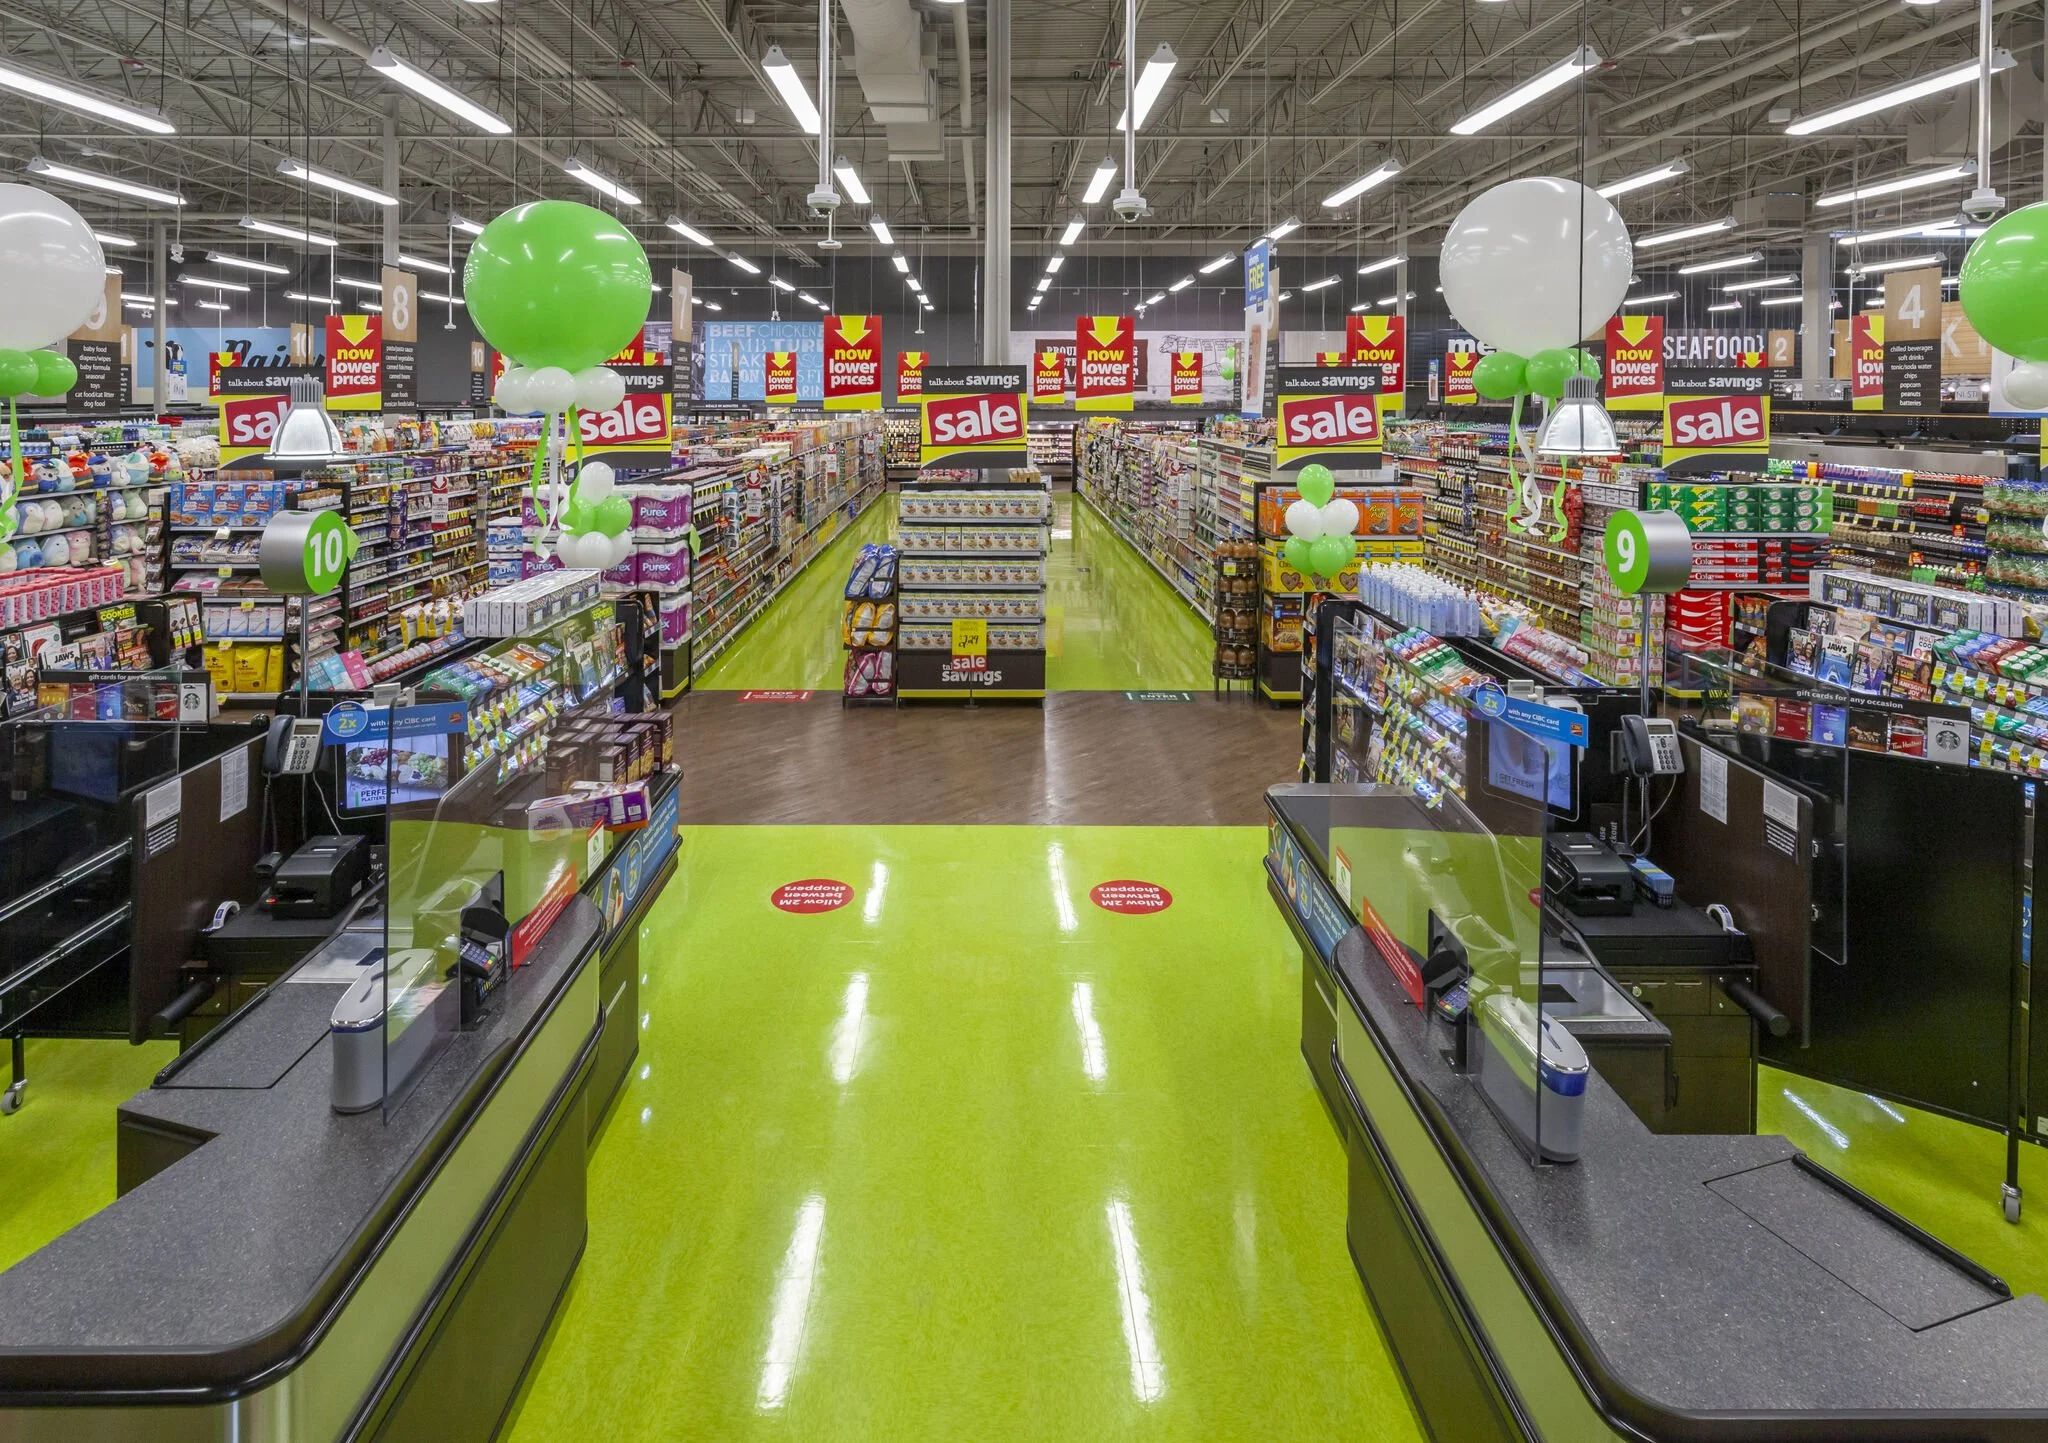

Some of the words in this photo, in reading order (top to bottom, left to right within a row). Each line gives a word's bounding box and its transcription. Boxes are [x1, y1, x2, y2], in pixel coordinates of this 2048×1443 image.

[1249, 262, 1264, 292] FREE
[392, 285, 409, 330] 8
[679, 286, 688, 330] 7
[1898, 285, 1925, 329] 4
[710, 324, 756, 337] BEEF
[758, 324, 816, 338] CHICKEN
[83, 345, 95, 353] baby
[293, 332, 312, 358] 10
[1774, 337, 1788, 362] 2
[1908, 344, 1933, 353] beverages
[337, 348, 374, 360] now
[472, 350, 483, 367] 10
[834, 349, 872, 360] now
[1087, 350, 1124, 361] now
[1358, 349, 1395, 360] now
[1616, 350, 1654, 360] now
[1862, 349, 1884, 360] no
[332, 358, 379, 374] lower
[830, 358, 878, 374] lower
[1082, 359, 1130, 374] lower
[1611, 359, 1658, 374] lower
[710, 370, 760, 383] BAON
[1452, 369, 1472, 377] now
[228, 379, 242, 387] talk
[244, 379, 264, 387] about
[333, 374, 376, 388] prices
[768, 376, 794, 384] lower
[831, 374, 874, 388] prices
[900, 376, 922, 384] lowe
[929, 378, 943, 386] talk
[944, 378, 964, 386] about
[966, 375, 1020, 388] savings
[1036, 376, 1062, 384] lower
[1084, 376, 1126, 388] prices
[1174, 376, 1200, 384] lower
[1286, 379, 1300, 387] talk
[1300, 379, 1320, 387] about
[1322, 376, 1375, 389] savings
[1612, 375, 1656, 388] prices
[1708, 376, 1762, 390] savings
[770, 383, 792, 391] prices
[902, 384, 922, 392] price
[1038, 384, 1061, 392] prices
[233, 401, 288, 442] sa
[579, 400, 662, 442] sale
[934, 400, 1018, 442] sale
[1290, 401, 1372, 442] sale
[1676, 402, 1760, 444] sale
[640, 507, 668, 517] Purex
[495, 533, 516, 542] ULTRA
[310, 528, 342, 577] 10
[1617, 529, 1636, 574] 9
[496, 566, 517, 576] ULTRA
[526, 561, 556, 571] Purex
[642, 562, 672, 572] Purex
[100, 607, 135, 620] COOKIES
[1828, 643, 1847, 654] JAWS
[54, 650, 74, 664] JAWS
[953, 655, 986, 670] sale
[942, 662, 952, 670] ta
[942, 670, 1002, 686] savings
[1484, 697, 1498, 710] 2x
[1812, 692, 1834, 700] cards
[1850, 696, 1866, 704] any
[1866, 698, 1904, 709] occasion
[338, 719, 356, 729] 2x
[1521, 711, 1532, 720] any
[1532, 714, 1546, 722] CIBC
[1546, 717, 1560, 726] card
[1609, 822, 1618, 844] ckout
